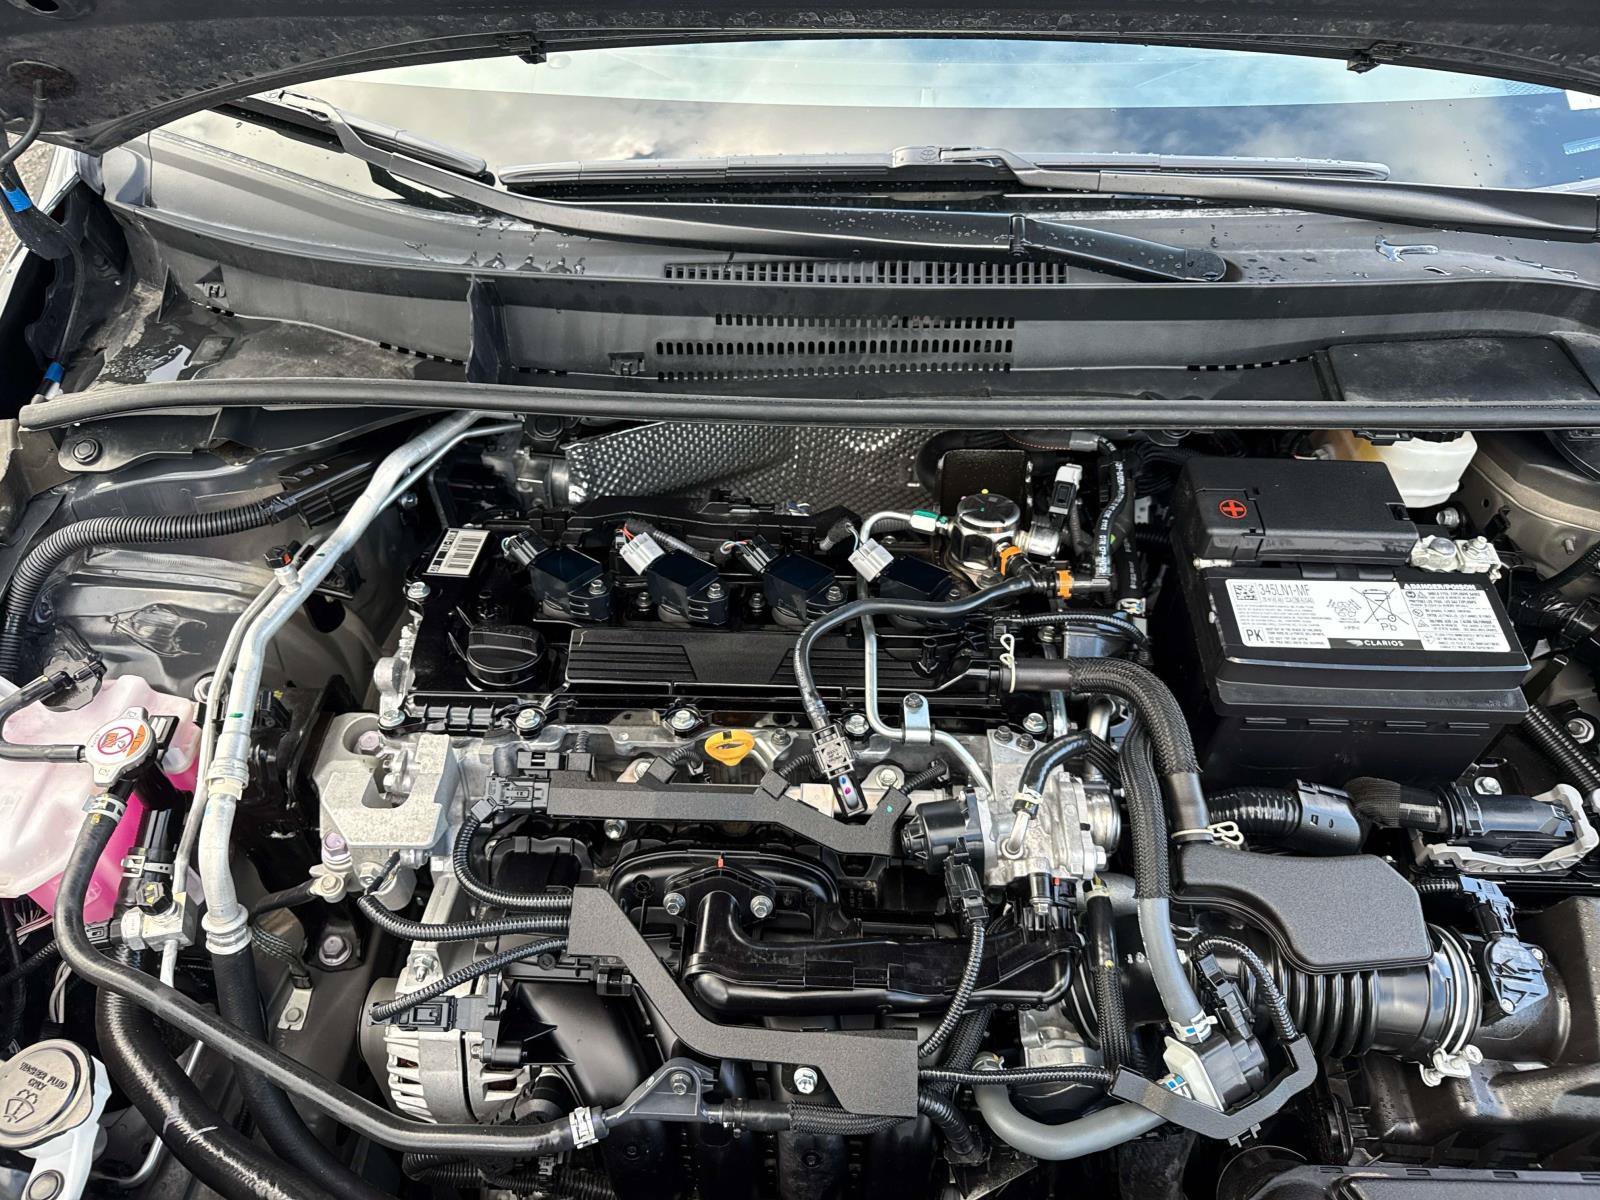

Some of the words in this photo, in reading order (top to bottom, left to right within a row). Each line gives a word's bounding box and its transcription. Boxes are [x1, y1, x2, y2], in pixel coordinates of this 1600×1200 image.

[1258, 583, 1310, 597] 345LN1-MF
[1381, 622, 1397, 632] Pb
[1245, 628, 1264, 642] PK
